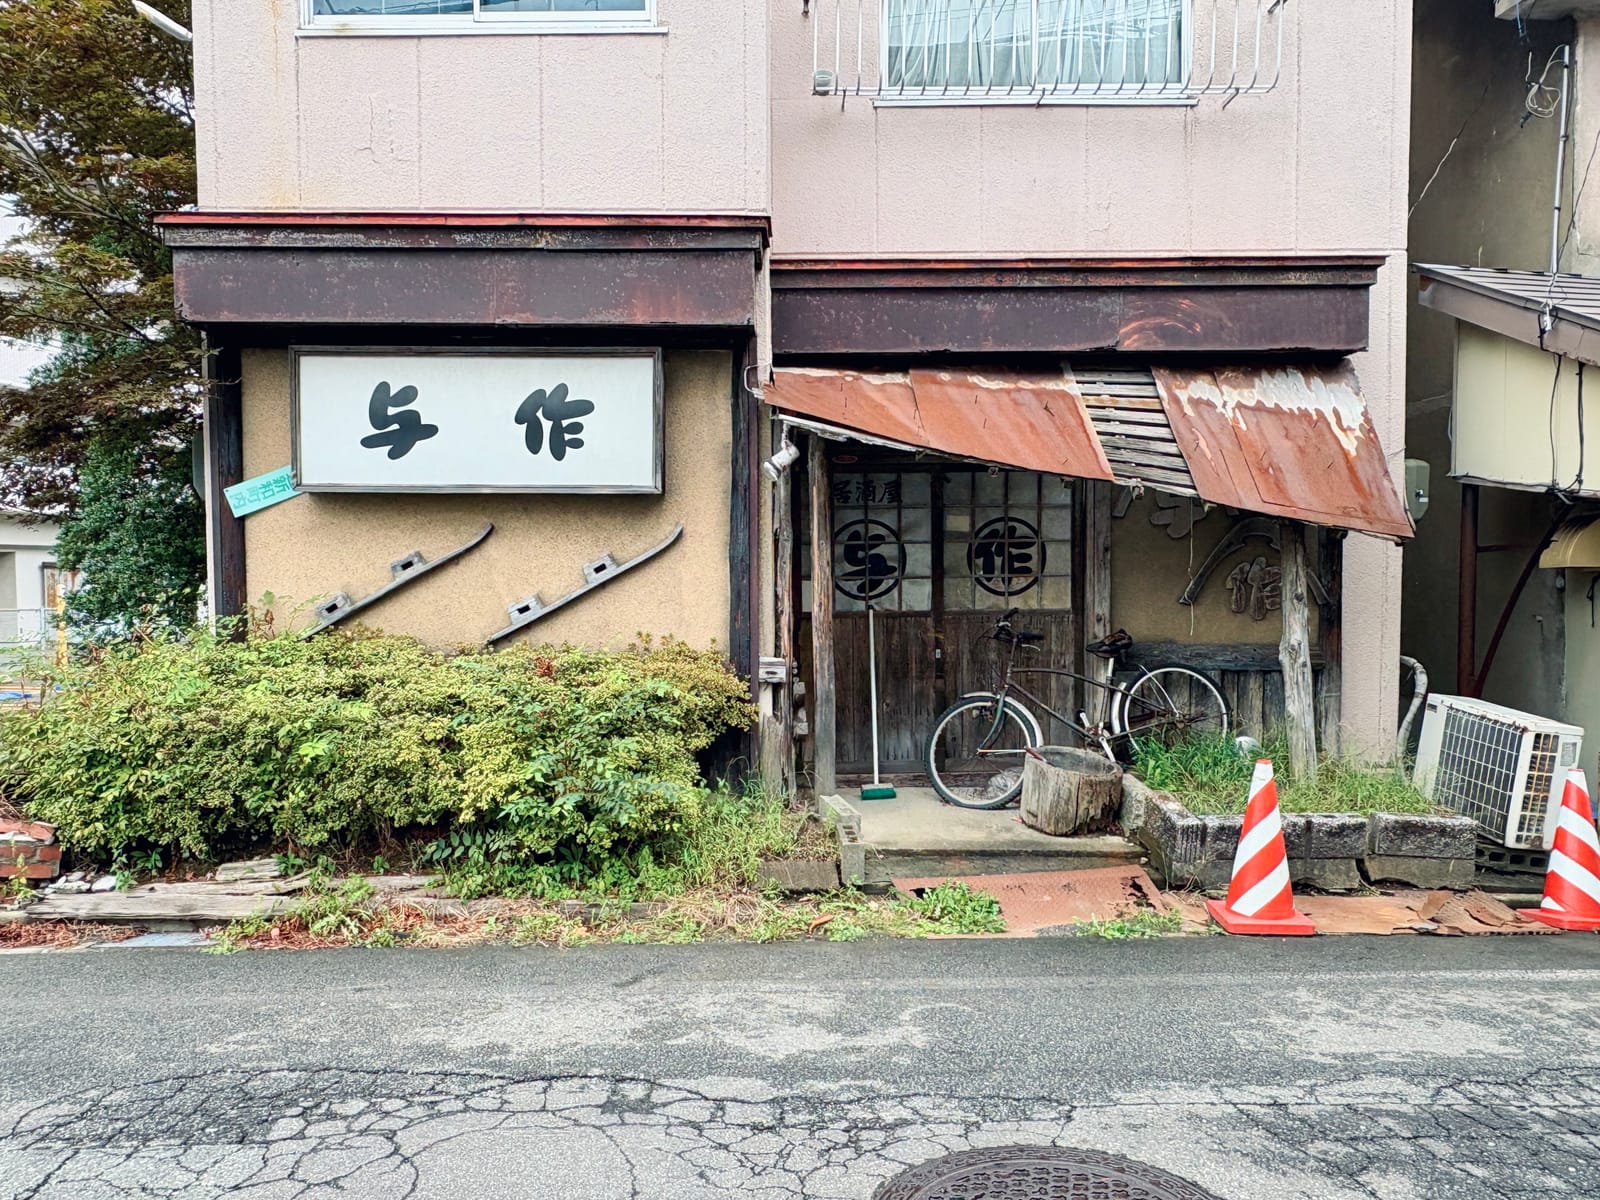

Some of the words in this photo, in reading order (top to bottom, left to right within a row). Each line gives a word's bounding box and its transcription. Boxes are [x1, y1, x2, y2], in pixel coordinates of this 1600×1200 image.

[360, 381, 595, 462] 与作
[230, 474, 292, 510] 新和町内
[831, 479, 902, 505] 居酒屋
[840, 530, 898, 594] 与
[974, 525, 1037, 585] 作
